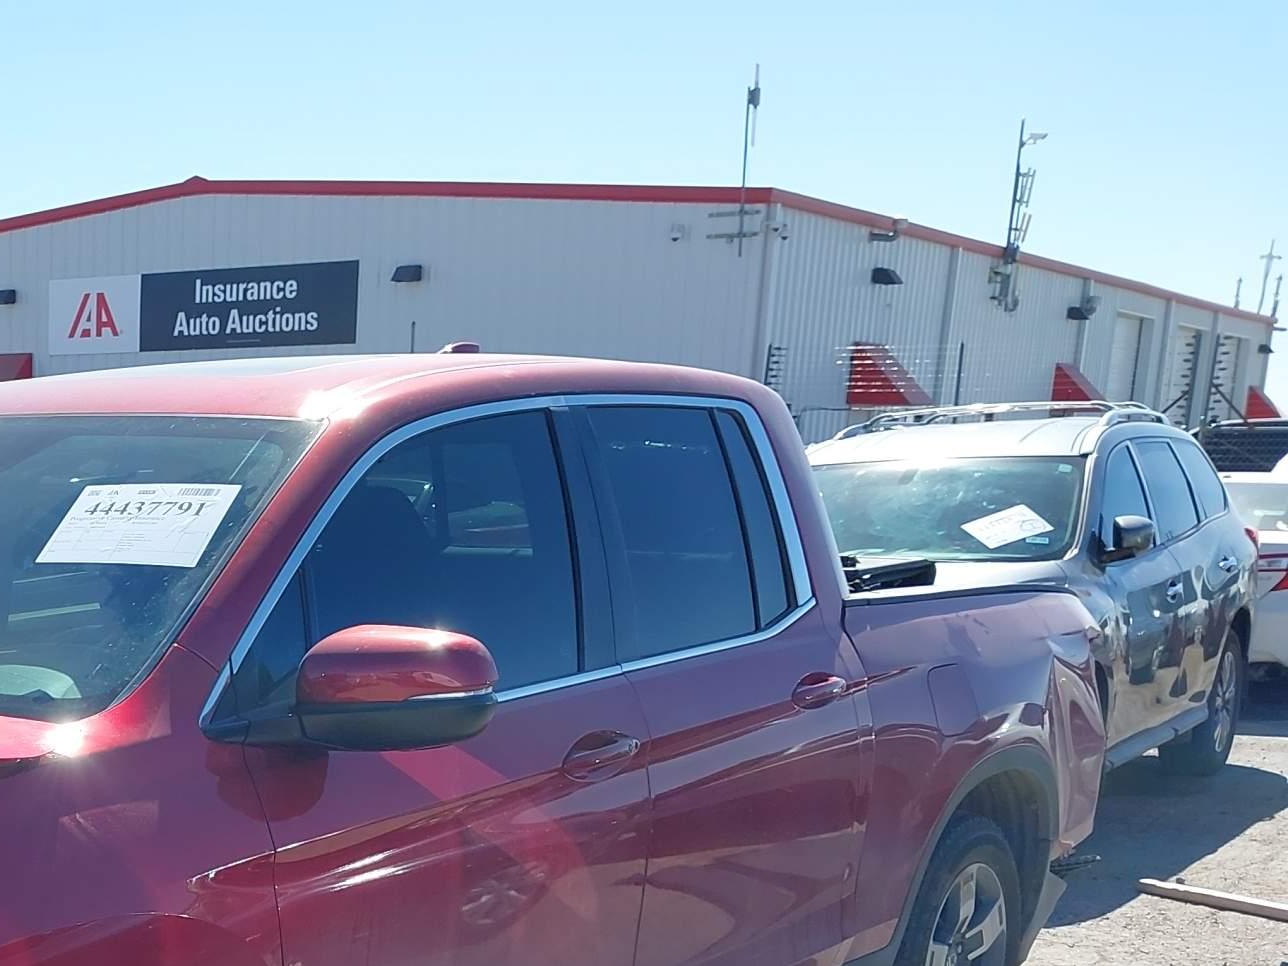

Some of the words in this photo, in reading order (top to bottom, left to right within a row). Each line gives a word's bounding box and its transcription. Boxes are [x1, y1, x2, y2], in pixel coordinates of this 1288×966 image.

[195, 279, 298, 304] Insurance
[173, 311, 221, 337] Auto
[225, 306, 319, 335] Auctions
[84, 501, 207, 516] 44437791
